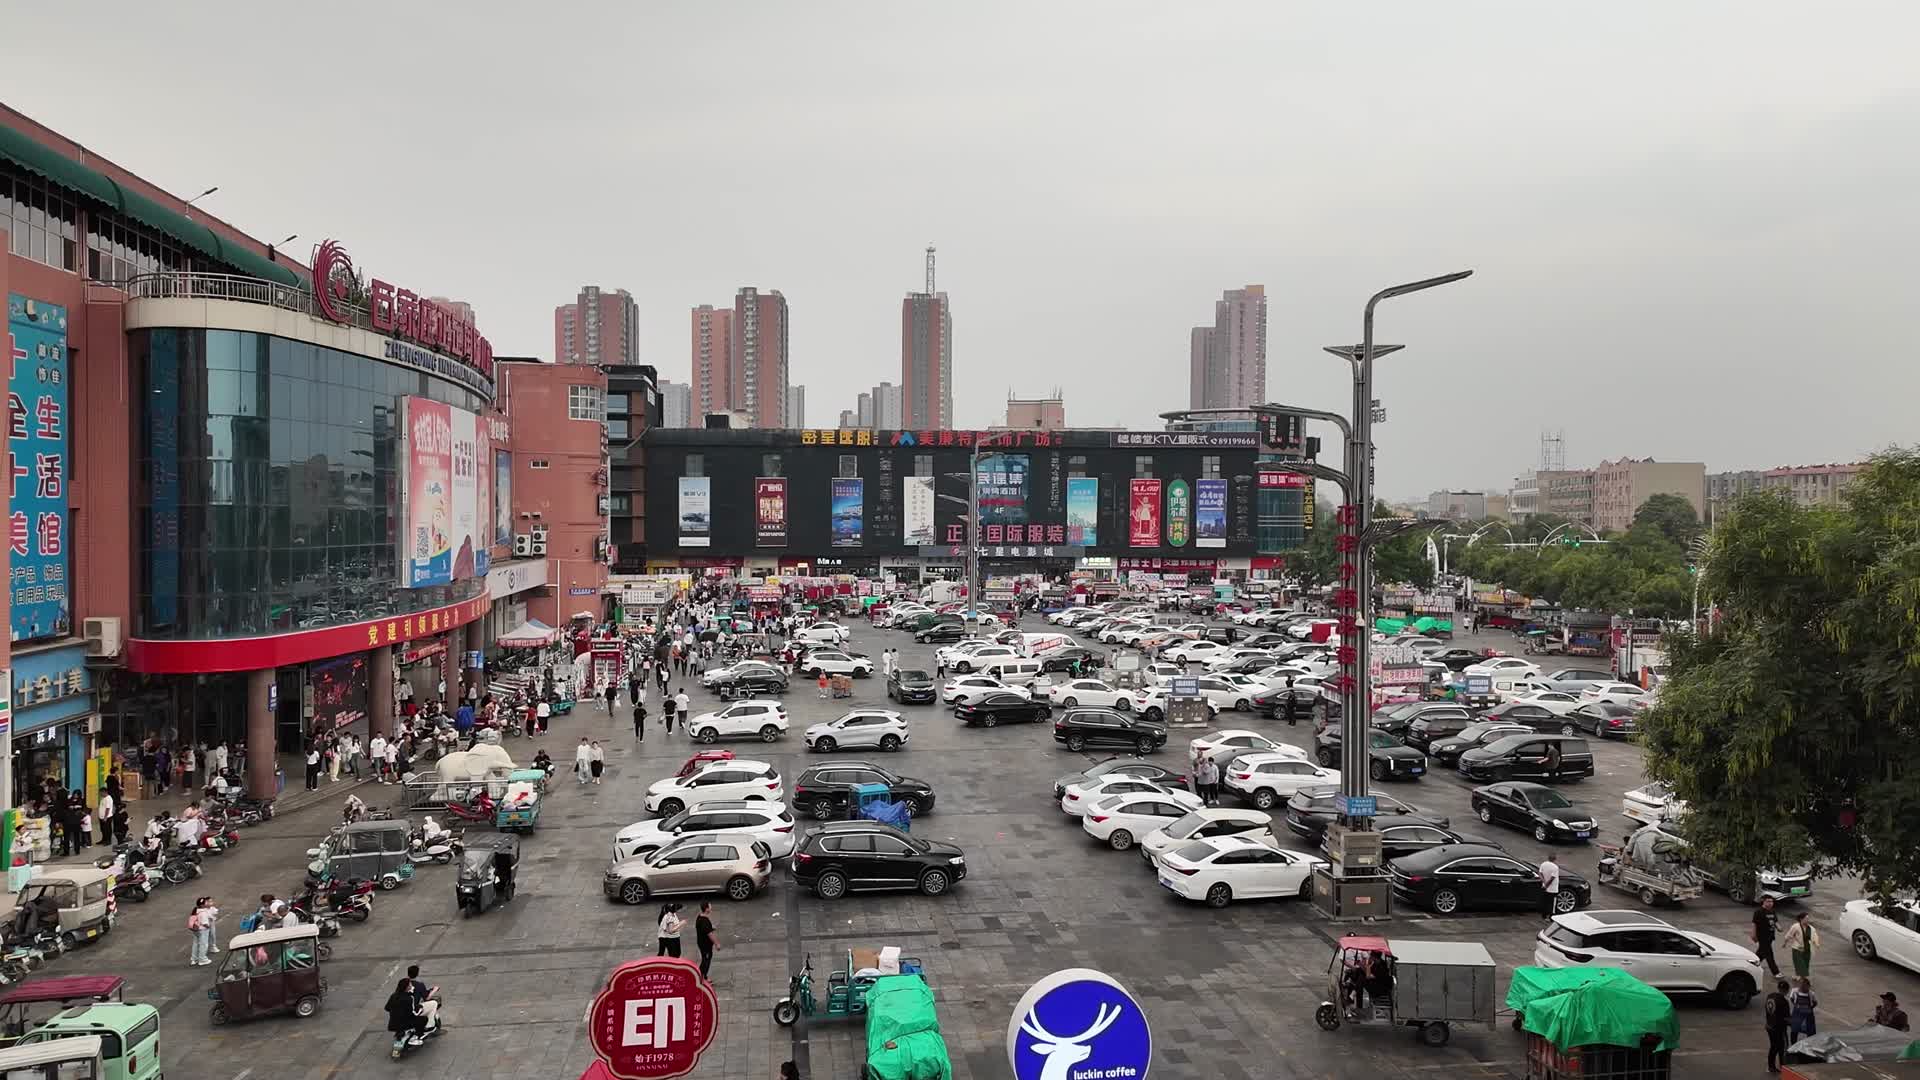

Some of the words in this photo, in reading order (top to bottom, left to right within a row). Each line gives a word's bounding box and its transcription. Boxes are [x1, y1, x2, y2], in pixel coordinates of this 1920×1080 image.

[36, 395, 62, 556] 生活馆
[979, 546, 1054, 557] 七星电影城
[367, 608, 459, 646] 党建引领聚合力
[18, 667, 83, 707] 十全十美
[36, 726, 56, 743] 玩具
[1073, 1069, 1103, 1080] luckin
[1105, 1066, 1136, 1078] coffee
